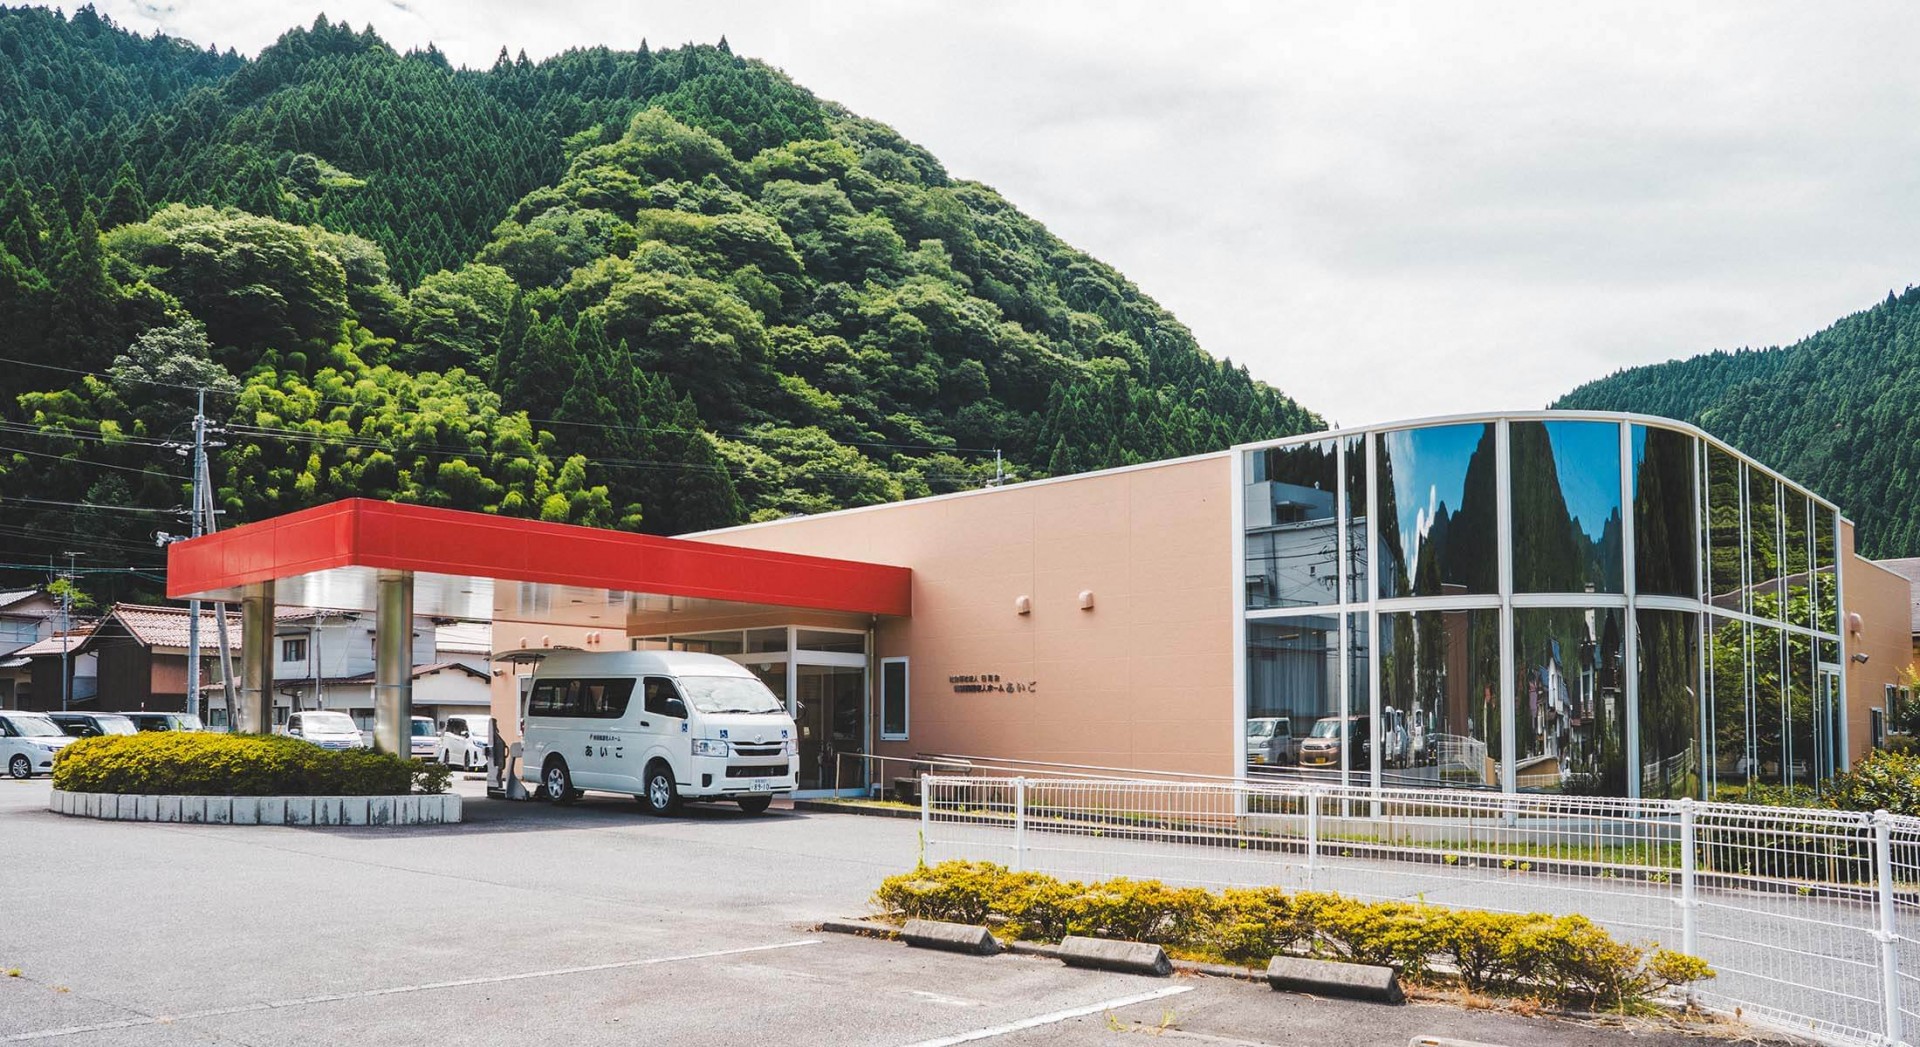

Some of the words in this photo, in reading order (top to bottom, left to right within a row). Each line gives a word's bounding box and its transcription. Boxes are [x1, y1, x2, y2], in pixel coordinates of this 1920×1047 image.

[1006, 681, 1037, 693] あいご
[585, 745, 623, 758] あいご
